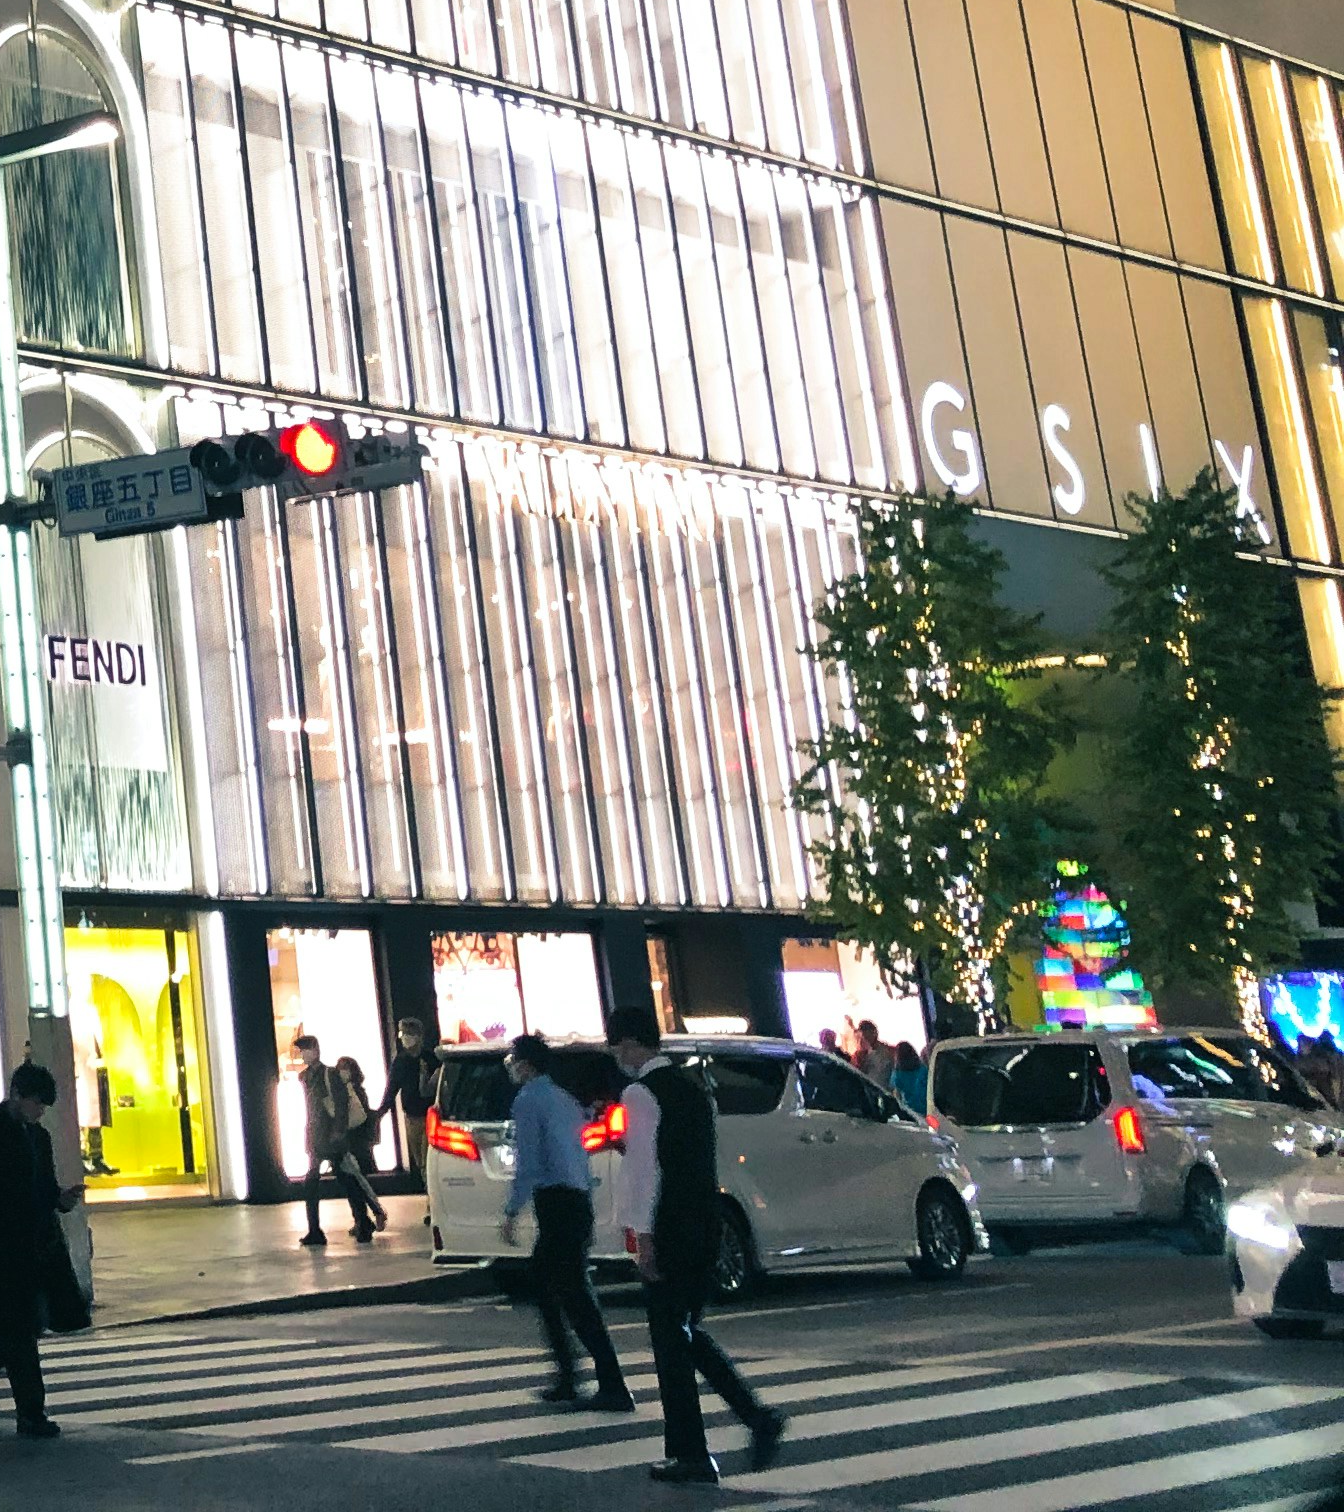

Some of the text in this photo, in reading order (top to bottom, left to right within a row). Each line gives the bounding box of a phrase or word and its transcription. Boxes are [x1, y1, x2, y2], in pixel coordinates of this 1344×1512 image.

[65, 465, 192, 512] 銀座五丁目
[105, 506, 142, 523] Ginza
[45, 634, 146, 687] FENDI
